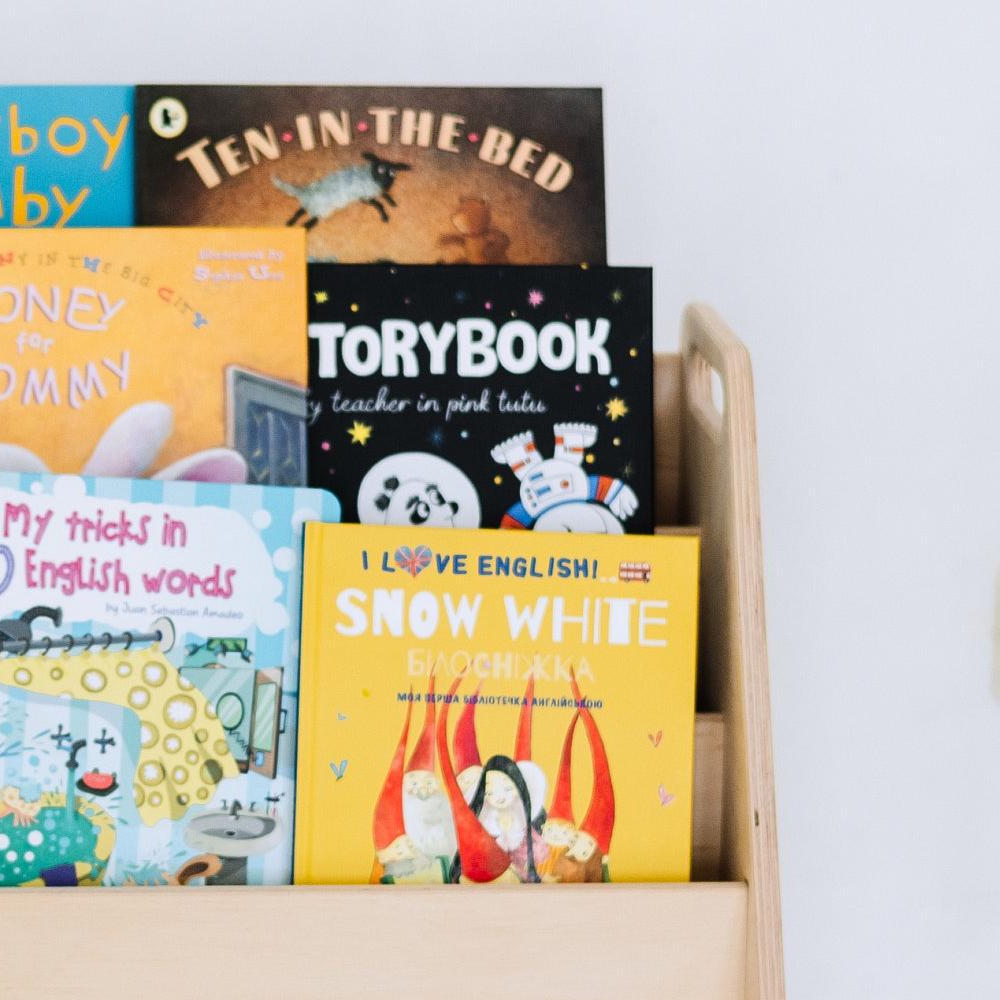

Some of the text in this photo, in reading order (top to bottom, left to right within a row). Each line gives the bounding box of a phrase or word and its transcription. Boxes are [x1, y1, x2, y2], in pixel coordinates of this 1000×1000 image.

[176, 106, 575, 193] TEN IN THE BED
[38, 252, 58, 267] IN
[157, 286, 208, 330] CITY
[16, 330, 55, 356] for
[308, 317, 612, 378] TORYBOOK
[329, 385, 411, 413] teacher
[416, 392, 439, 413] in
[446, 387, 490, 421] pink
[497, 390, 548, 413] tutu
[3, 502, 188, 547] My tricks in
[24, 548, 131, 597] English
[141, 563, 238, 599] words
[477, 554, 599, 580] ENGLISH!
[334, 587, 669, 648] SNOW WHITE
